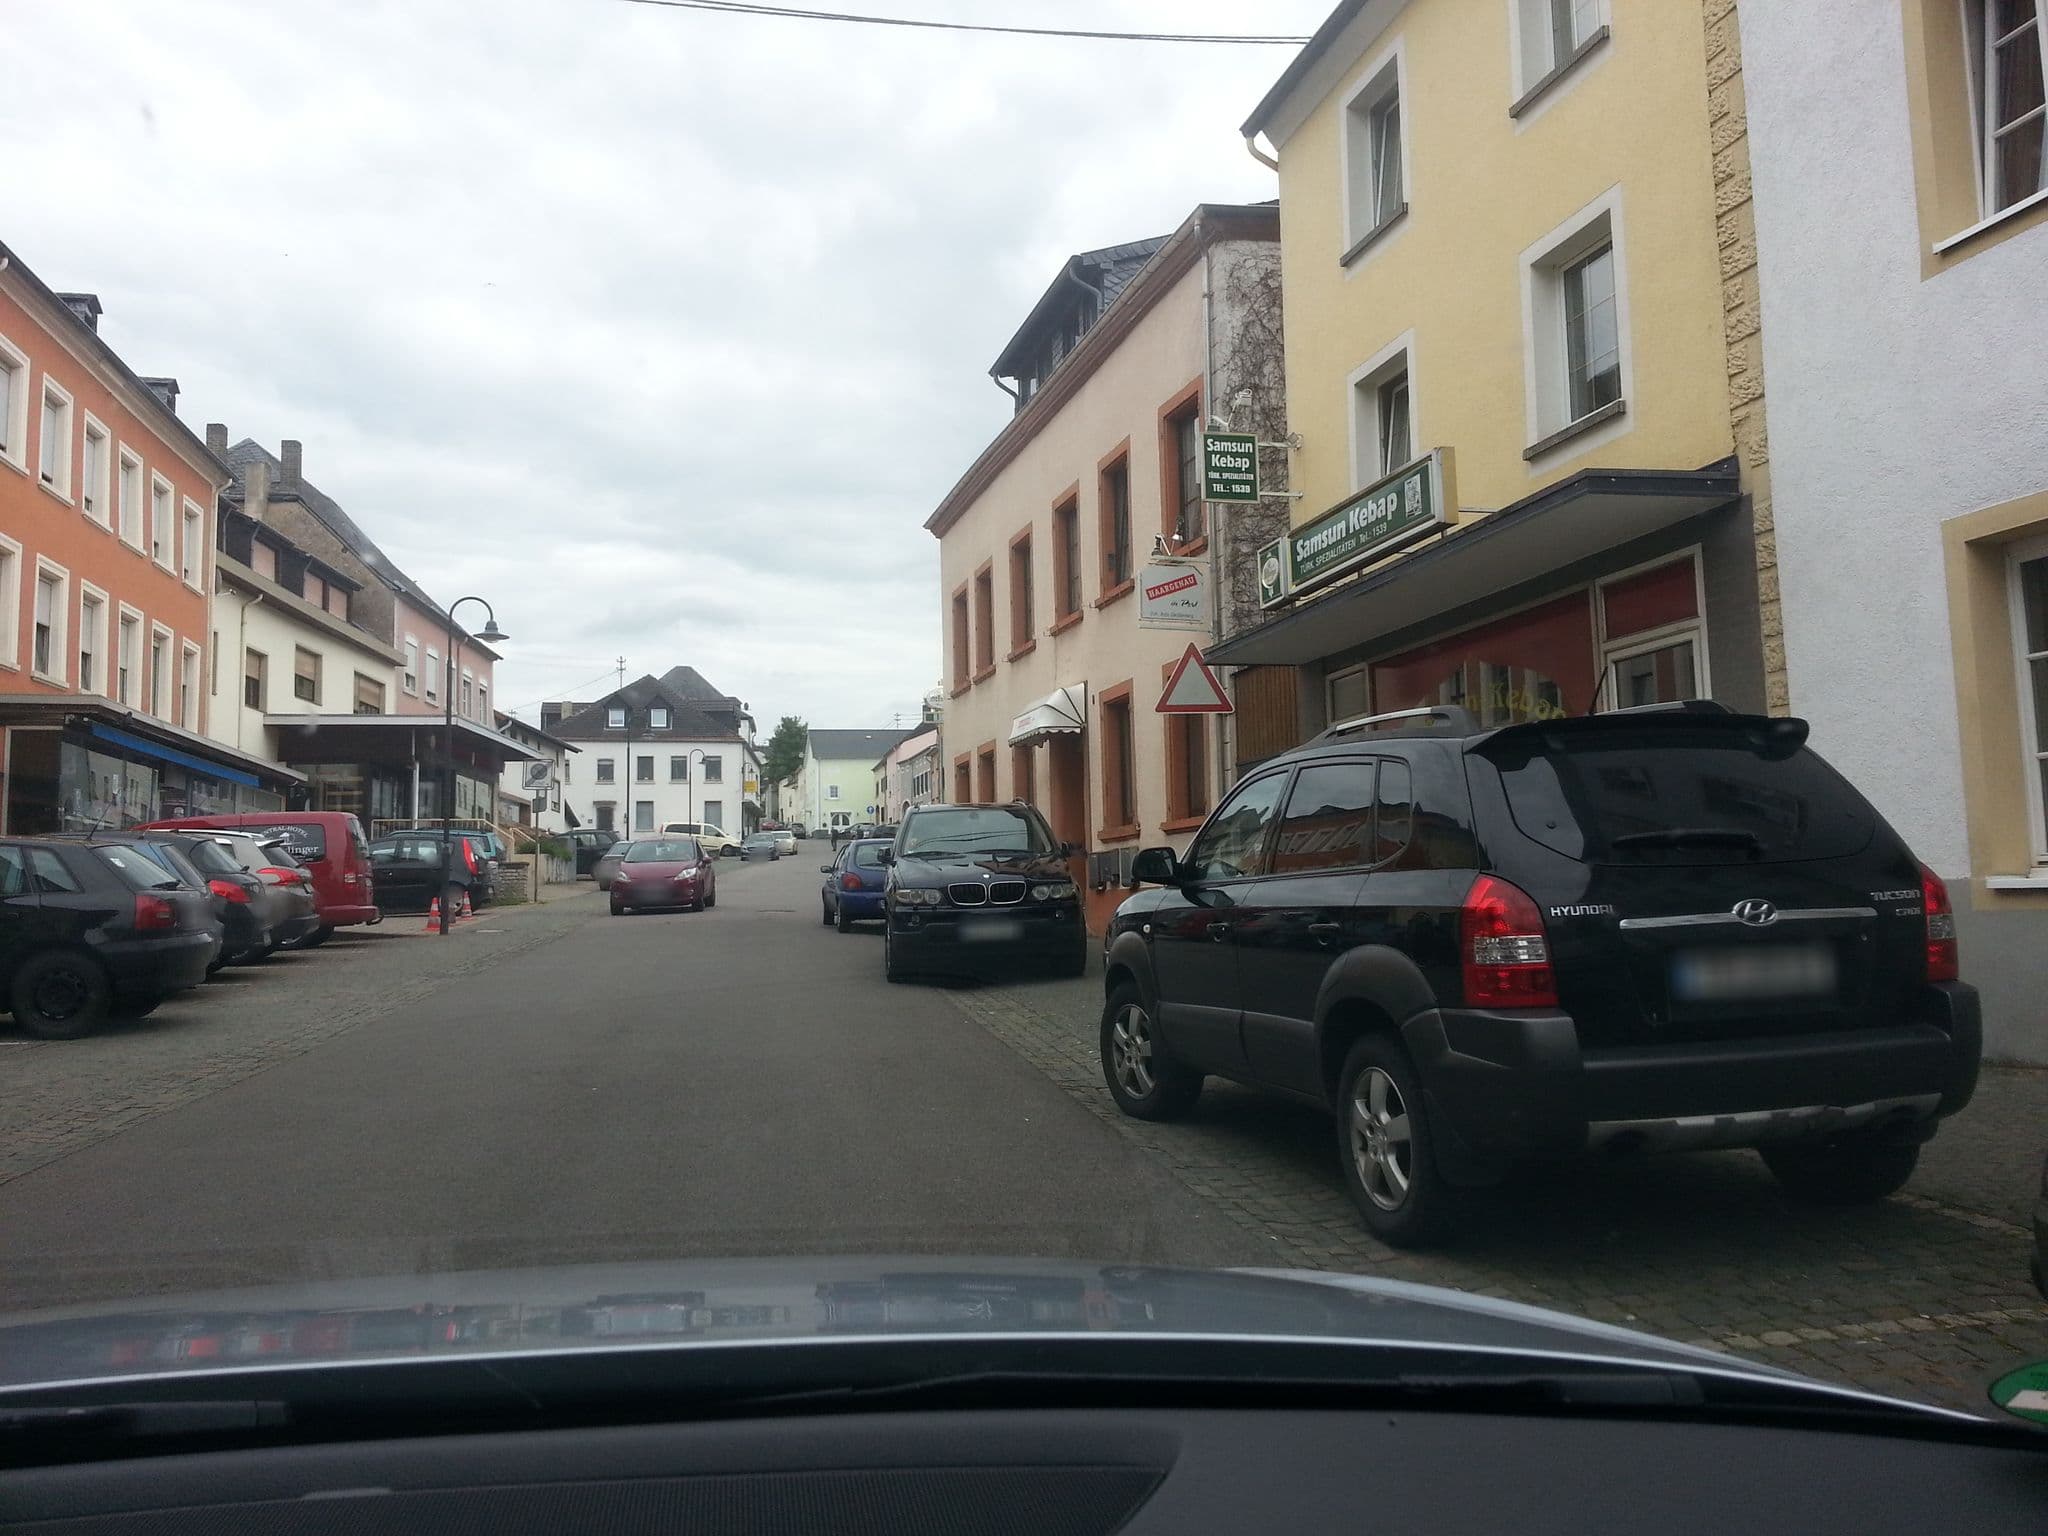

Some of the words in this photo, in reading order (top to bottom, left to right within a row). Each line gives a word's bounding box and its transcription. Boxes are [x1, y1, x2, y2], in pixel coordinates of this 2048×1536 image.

[1206, 438, 1253, 453] Samsun
[1211, 454, 1250, 471] Kebap
[1296, 520, 1346, 561] Samsun
[1349, 492, 1398, 534] Kebap
[1372, 522, 1387, 537] 1539
[1148, 576, 1195, 598] HAARGENAU
[1550, 904, 1614, 916] HYUNDAI
